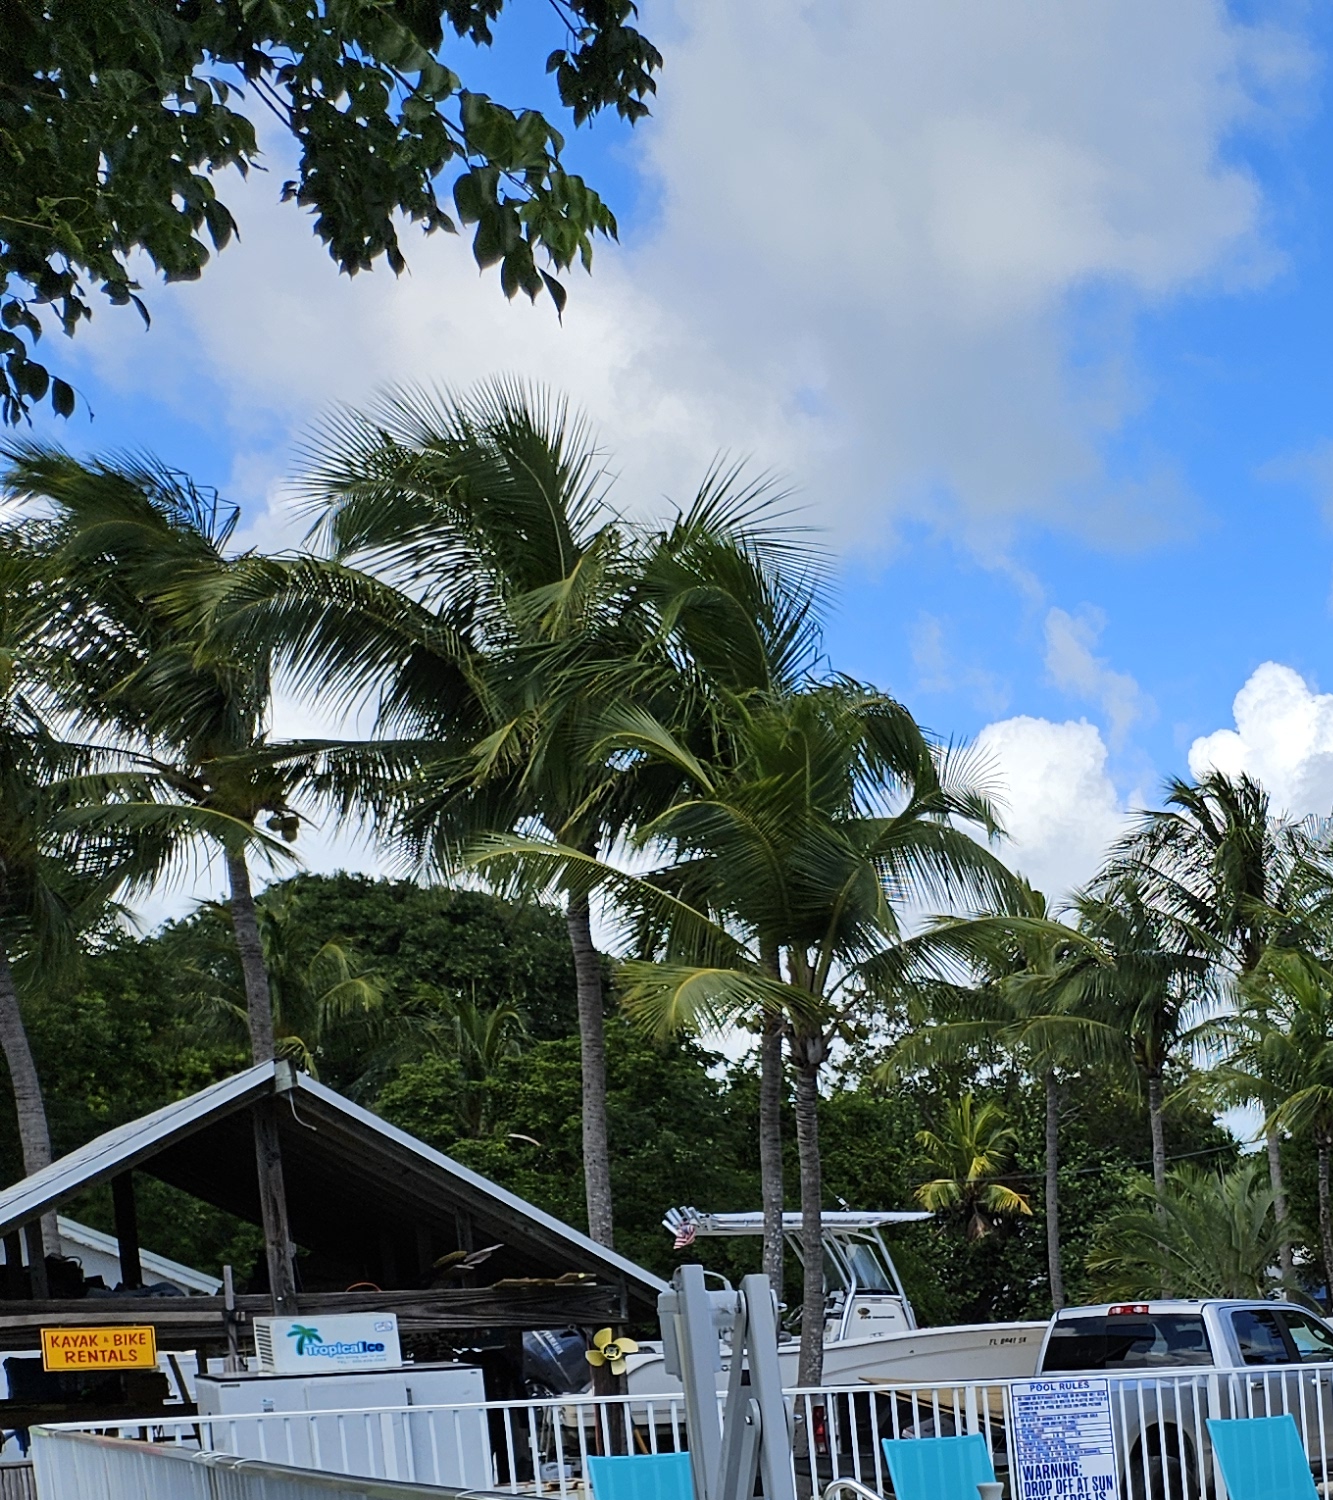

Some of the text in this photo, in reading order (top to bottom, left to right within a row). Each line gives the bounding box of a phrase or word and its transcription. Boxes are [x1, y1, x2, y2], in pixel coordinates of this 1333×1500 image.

[50, 1334, 99, 1348] KAYAK
[113, 1333, 147, 1347] BIKE
[64, 1349, 138, 1364] RENTALS
[1030, 1381, 1090, 1392] POOL RULES
[1022, 1461, 1083, 1481] WARNING:
[1024, 1474, 1113, 1498] DROP OFF AT SUN
